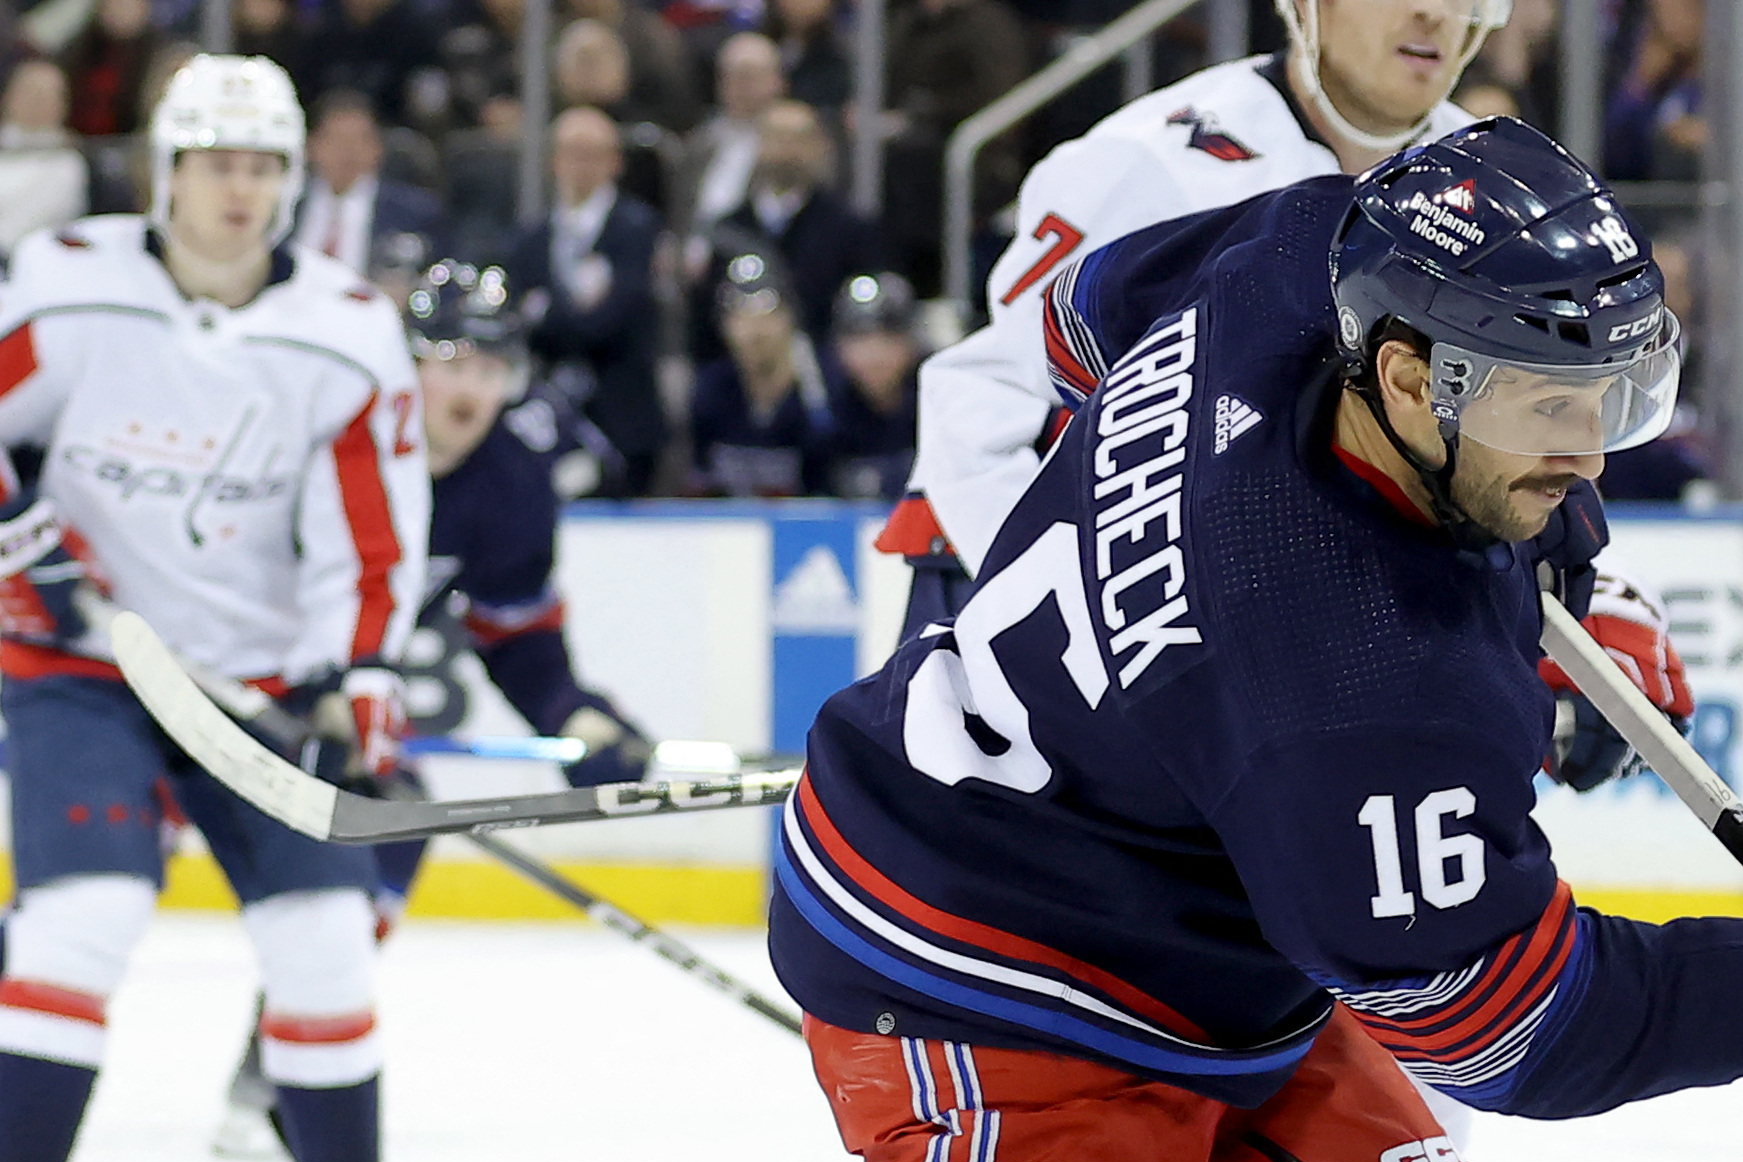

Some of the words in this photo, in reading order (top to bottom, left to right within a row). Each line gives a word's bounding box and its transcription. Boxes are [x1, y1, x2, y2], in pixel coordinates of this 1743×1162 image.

[1408, 191, 1486, 246] Benjamin
[1410, 214, 1467, 257] Moore
[1607, 307, 1664, 342] CCM
[1215, 395, 1230, 455] adidas
[1094, 307, 1203, 690] TROCHECK
[1358, 786, 1487, 918] 16
